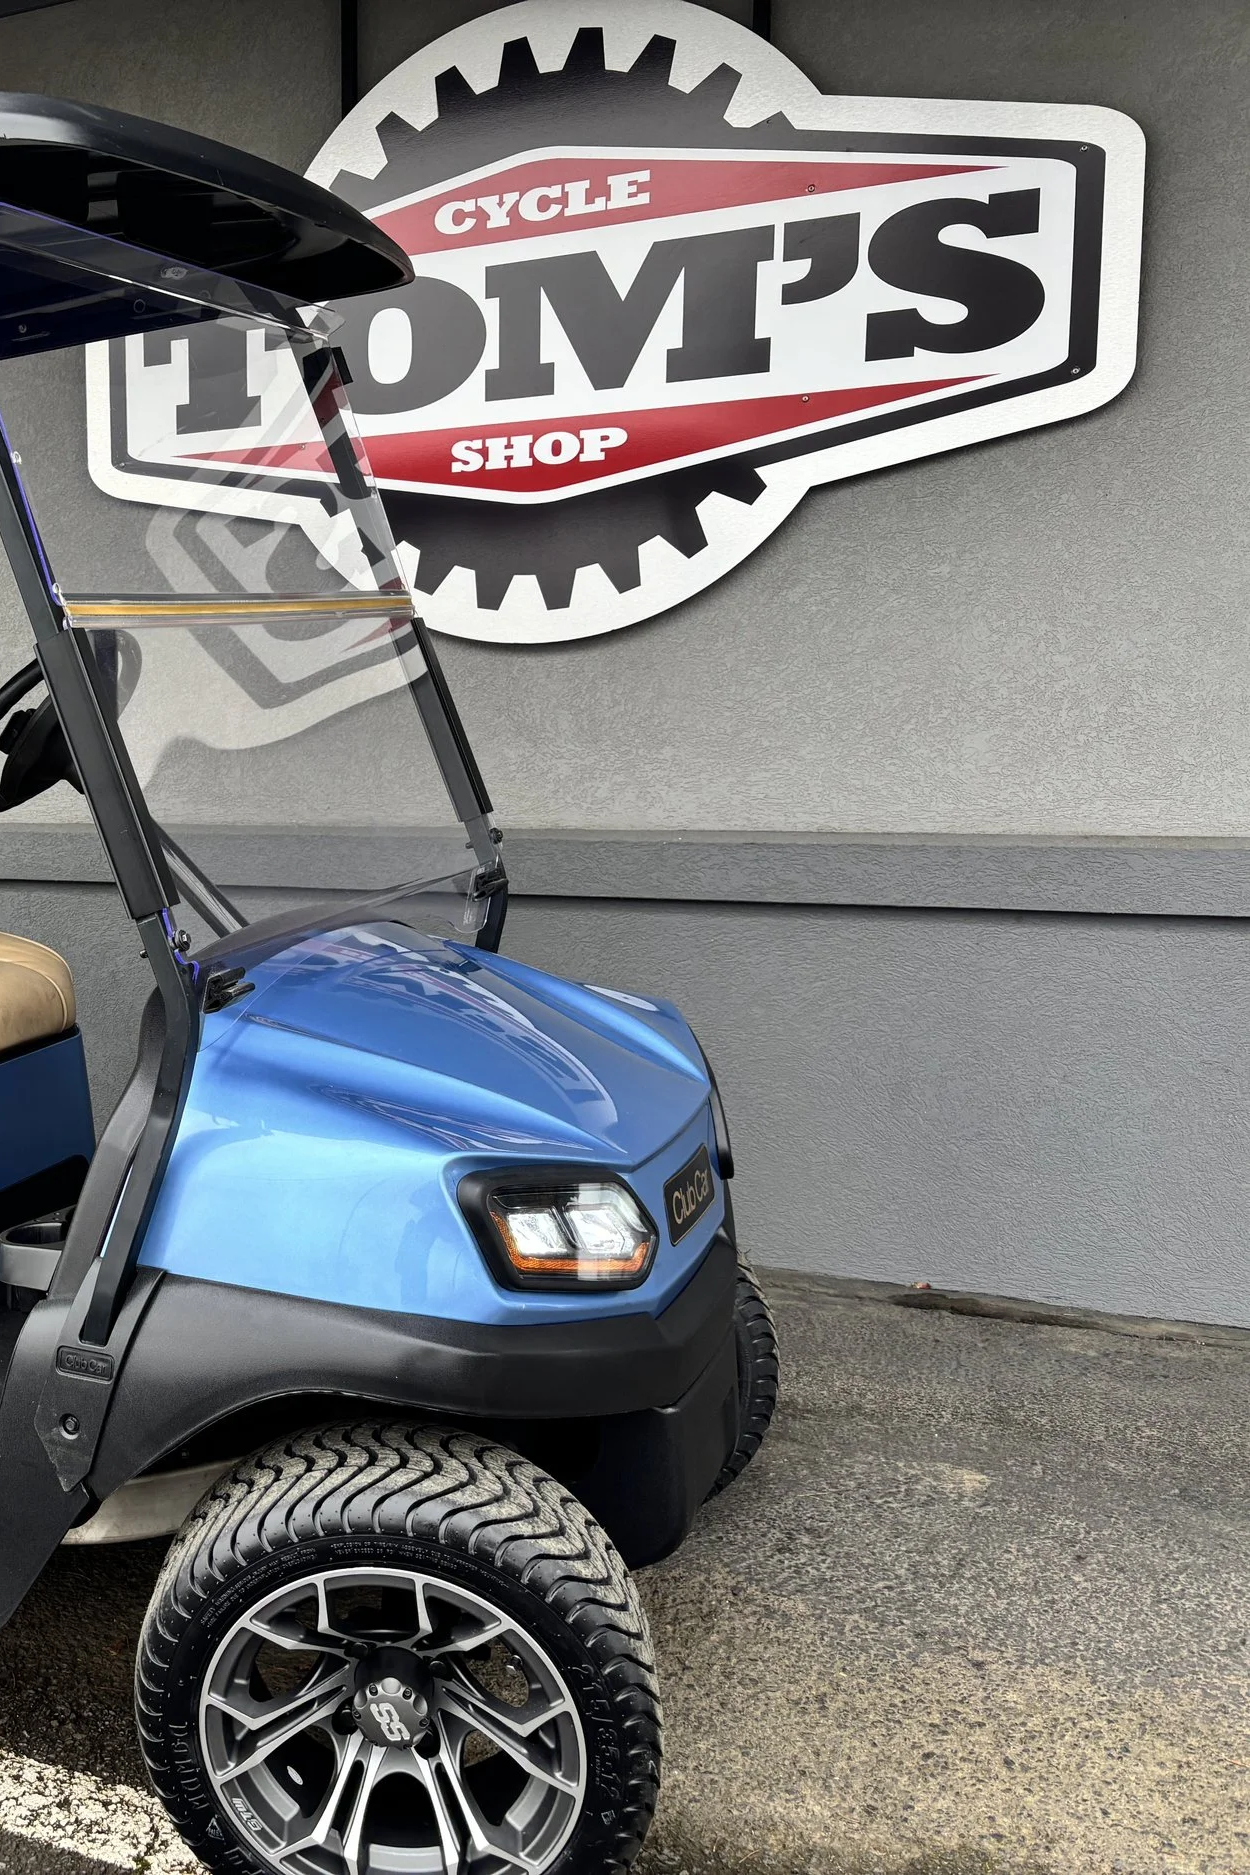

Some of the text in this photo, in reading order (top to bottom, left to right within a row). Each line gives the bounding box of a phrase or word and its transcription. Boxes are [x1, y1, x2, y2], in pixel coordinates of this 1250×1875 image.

[434, 169, 651, 236] CYCLE
[143, 188, 1046, 434] TOM'S
[450, 426, 628, 474] SHOP
[672, 1180, 696, 1224] Club
[65, 1354, 106, 1374] Club Car
[369, 1702, 411, 1742] SS
[231, 1797, 263, 1831] GTW
